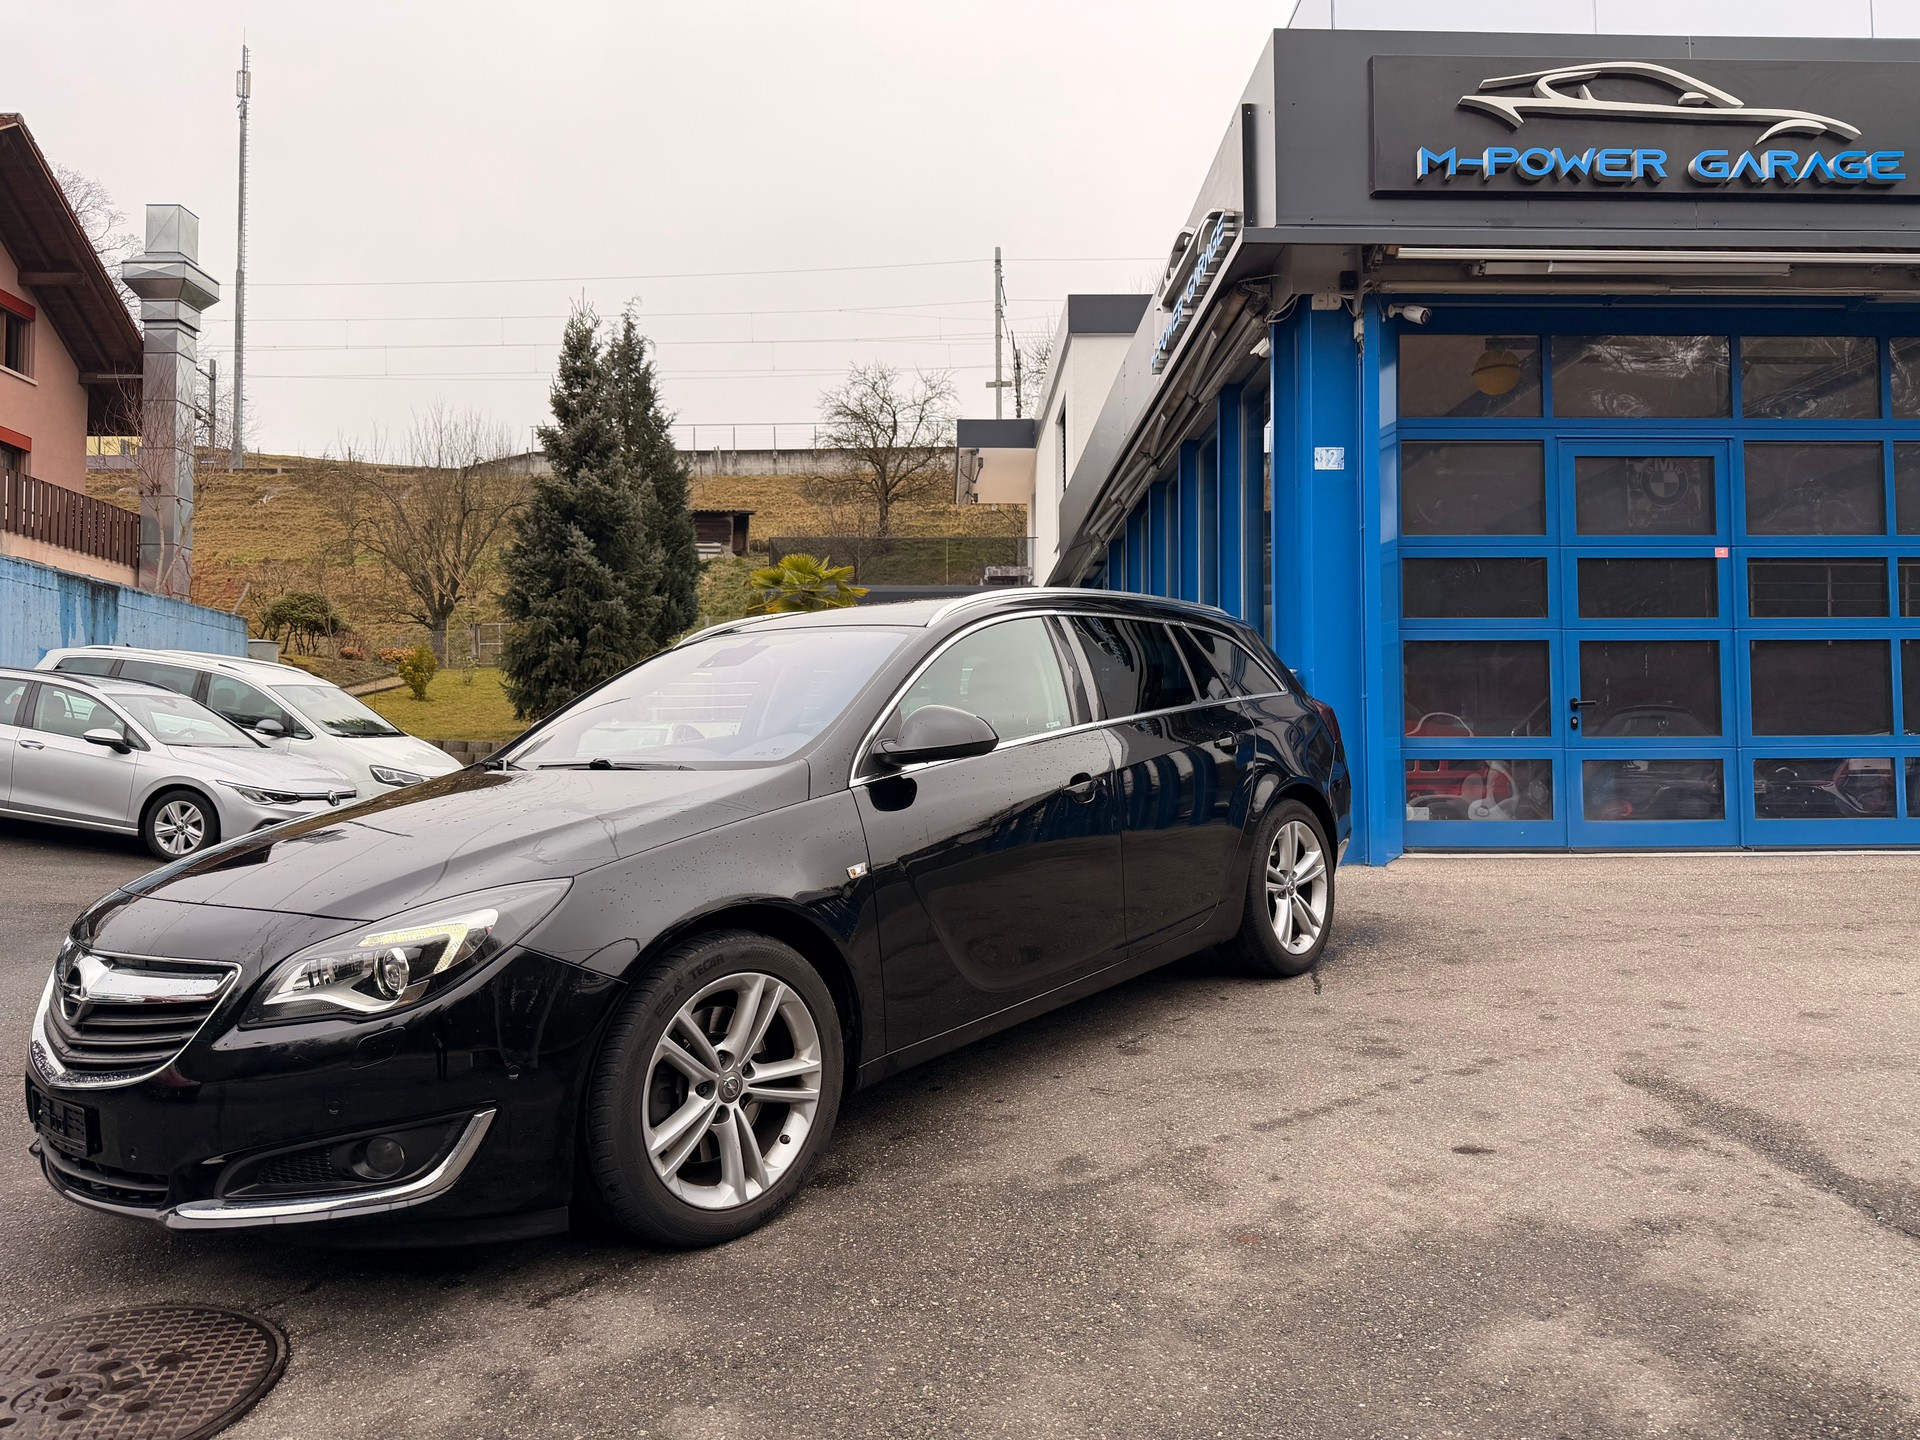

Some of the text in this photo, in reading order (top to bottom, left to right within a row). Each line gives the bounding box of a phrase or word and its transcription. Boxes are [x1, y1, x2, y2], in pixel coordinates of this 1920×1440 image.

[1417, 147, 1907, 184] M-POWER GARAGE
[1186, 211, 1225, 304] GARAGE
[688, 954, 725, 980] TECAR
